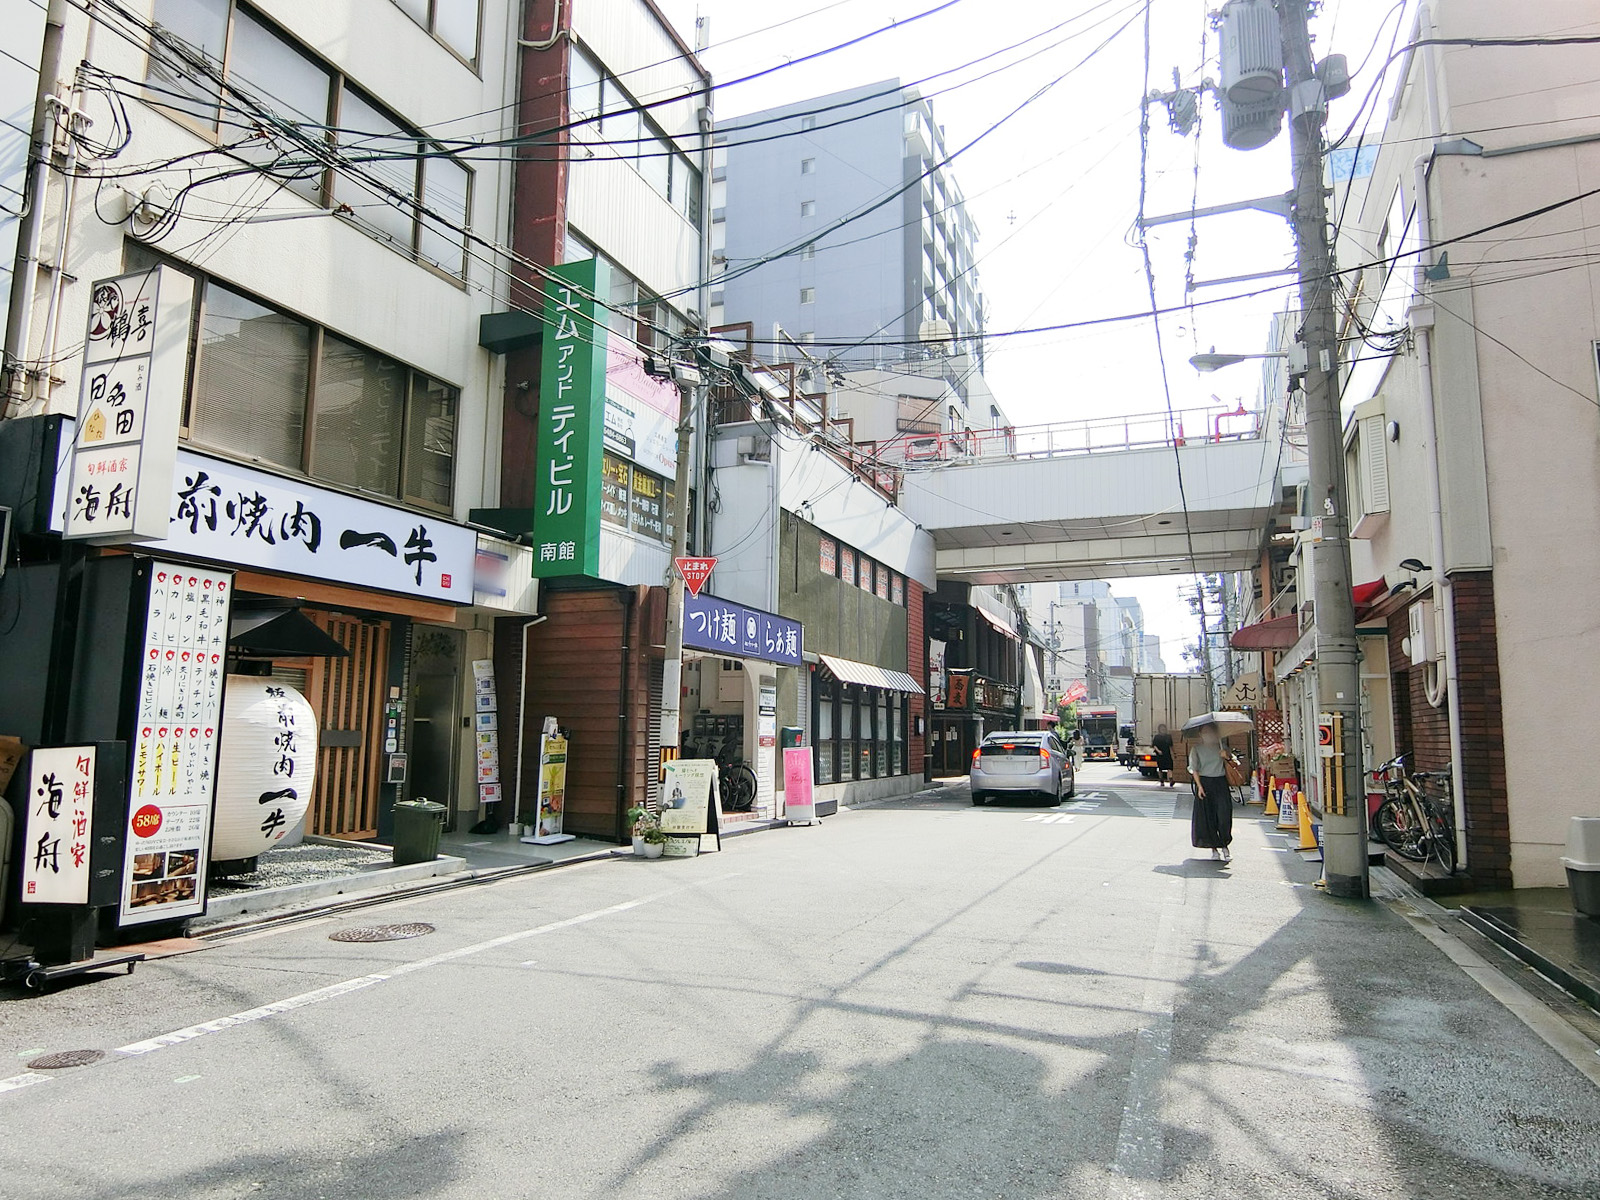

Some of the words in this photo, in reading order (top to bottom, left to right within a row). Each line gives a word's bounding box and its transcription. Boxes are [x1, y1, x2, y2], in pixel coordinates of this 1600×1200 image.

[87, 457, 128, 476] 旬鮮酒家
[74, 482, 133, 522] 海舟
[170, 471, 321, 553] 前焼肉
[340, 524, 437, 586] 一牛
[540, 540, 576, 562] 南館
[683, 561, 709, 571] 止まれ
[686, 572, 705, 580] STOP
[152, 588, 164, 641] ハラミ
[167, 591, 179, 642] カルビ
[183, 592, 196, 643] 塩タン
[197, 594, 210, 645] 黒毛和牛
[211, 597, 226, 646] 神戸牛
[689, 608, 737, 645] つけ麺
[158, 665, 173, 719] 冷麺
[191, 667, 203, 719] テッチャン
[206, 668, 219, 720] 焼きレバー
[137, 742, 148, 798] レモンサワー
[152, 742, 166, 796] ハイボール
[168, 741, 181, 795] 生ビール
[184, 742, 196, 795] しゃぶしゃぶ
[200, 742, 211, 795] すき焼き
[33, 772, 64, 874] 海舟
[70, 754, 91, 868] 旬鮮酒家
[136, 813, 160, 828] 58席
